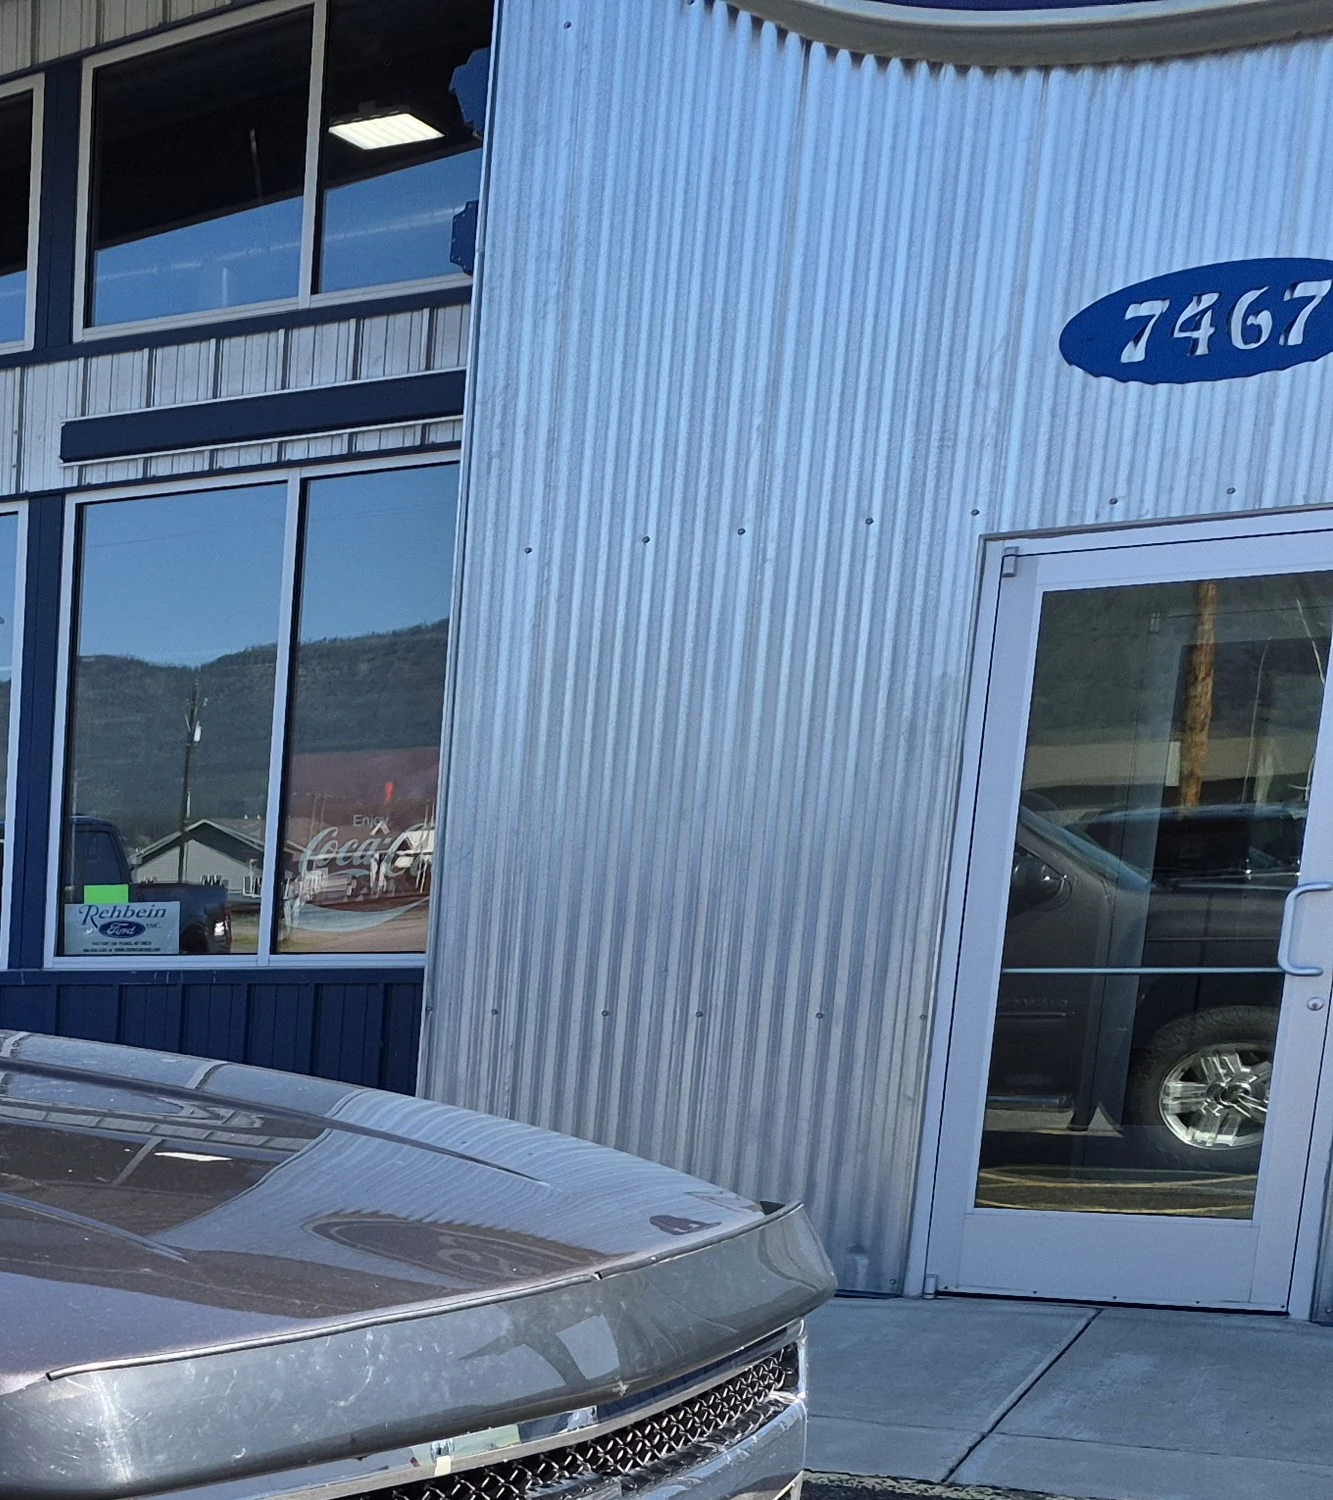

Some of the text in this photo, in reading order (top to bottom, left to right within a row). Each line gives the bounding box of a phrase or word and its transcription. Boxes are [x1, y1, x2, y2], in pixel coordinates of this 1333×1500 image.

[1120, 279, 1332, 363] 7467
[78, 904, 167, 929] Rehbein
[106, 922, 136, 937] Ford
